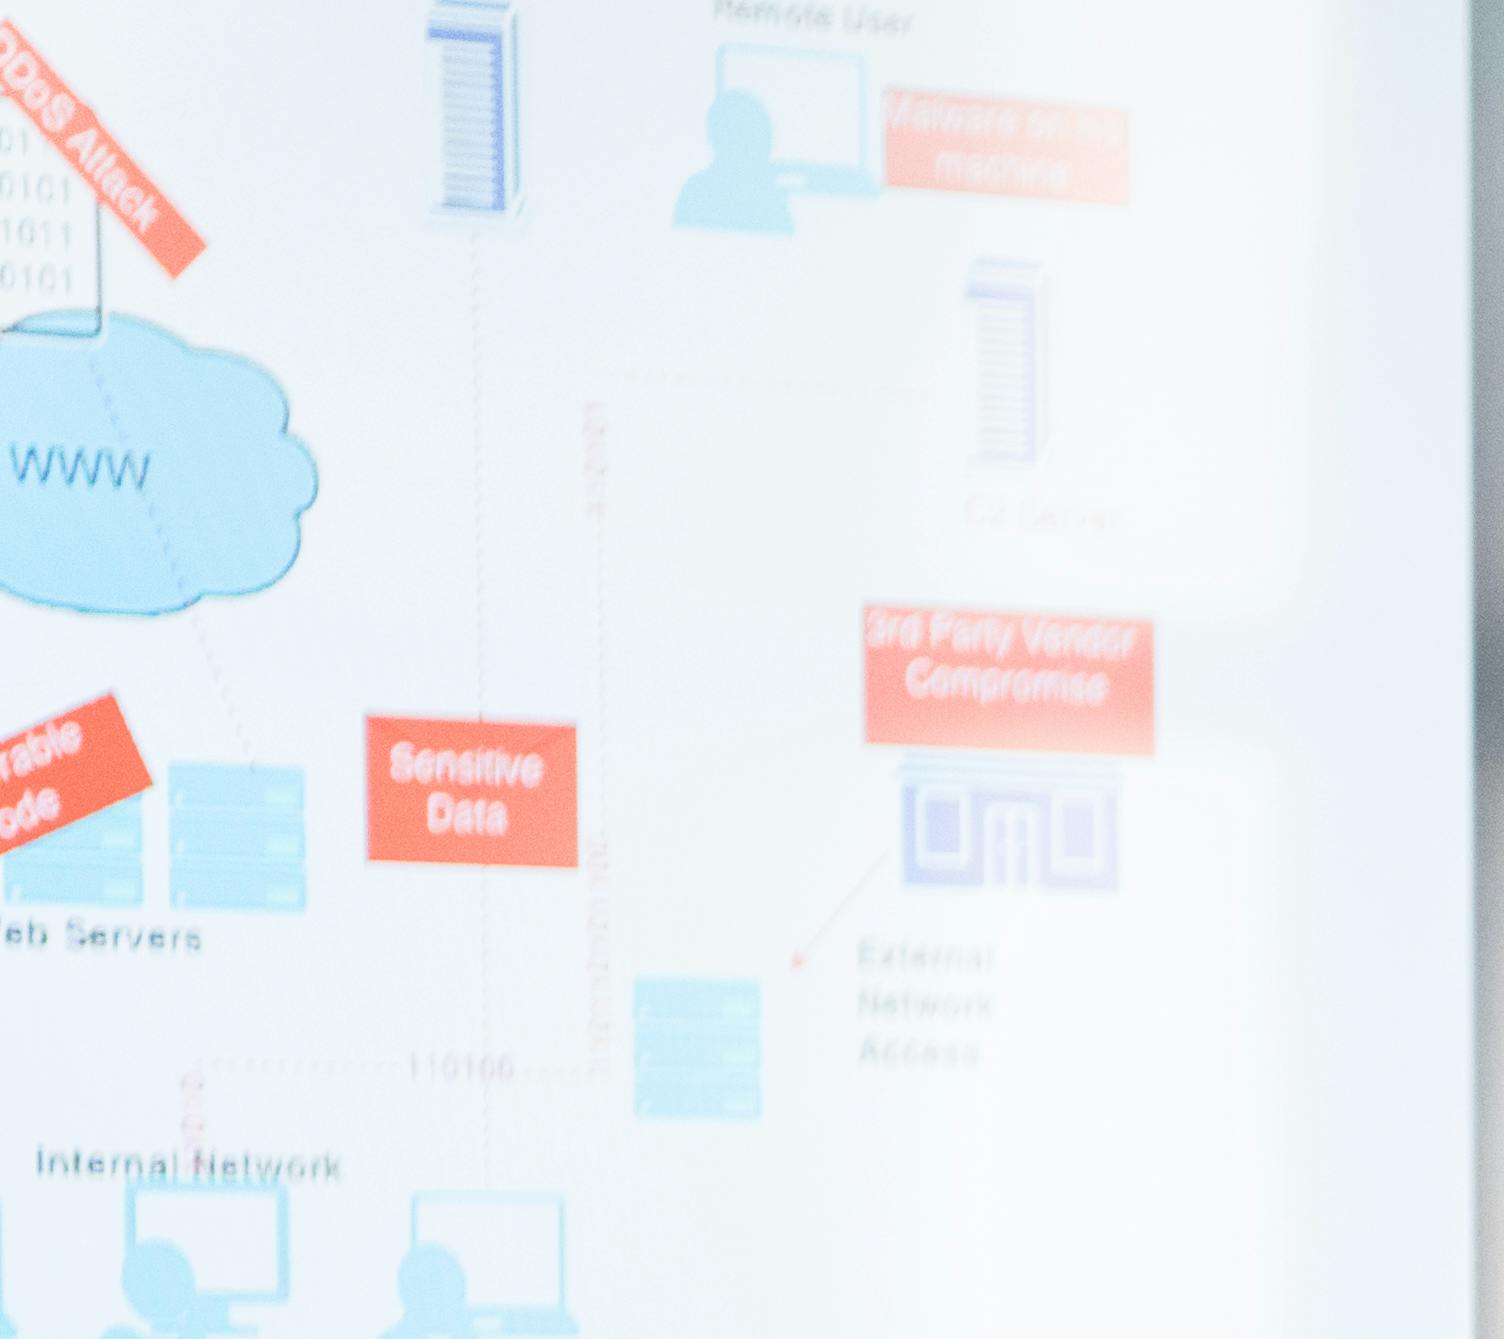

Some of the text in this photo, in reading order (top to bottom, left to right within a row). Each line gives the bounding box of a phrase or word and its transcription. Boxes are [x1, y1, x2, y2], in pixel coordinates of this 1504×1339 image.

[904, 656, 1110, 707] Compromise
[388, 740, 546, 789] Sensitive
[426, 790, 509, 837] Data
[66, 915, 203, 954] Servers
[34, 1143, 344, 1182] Internal Network
